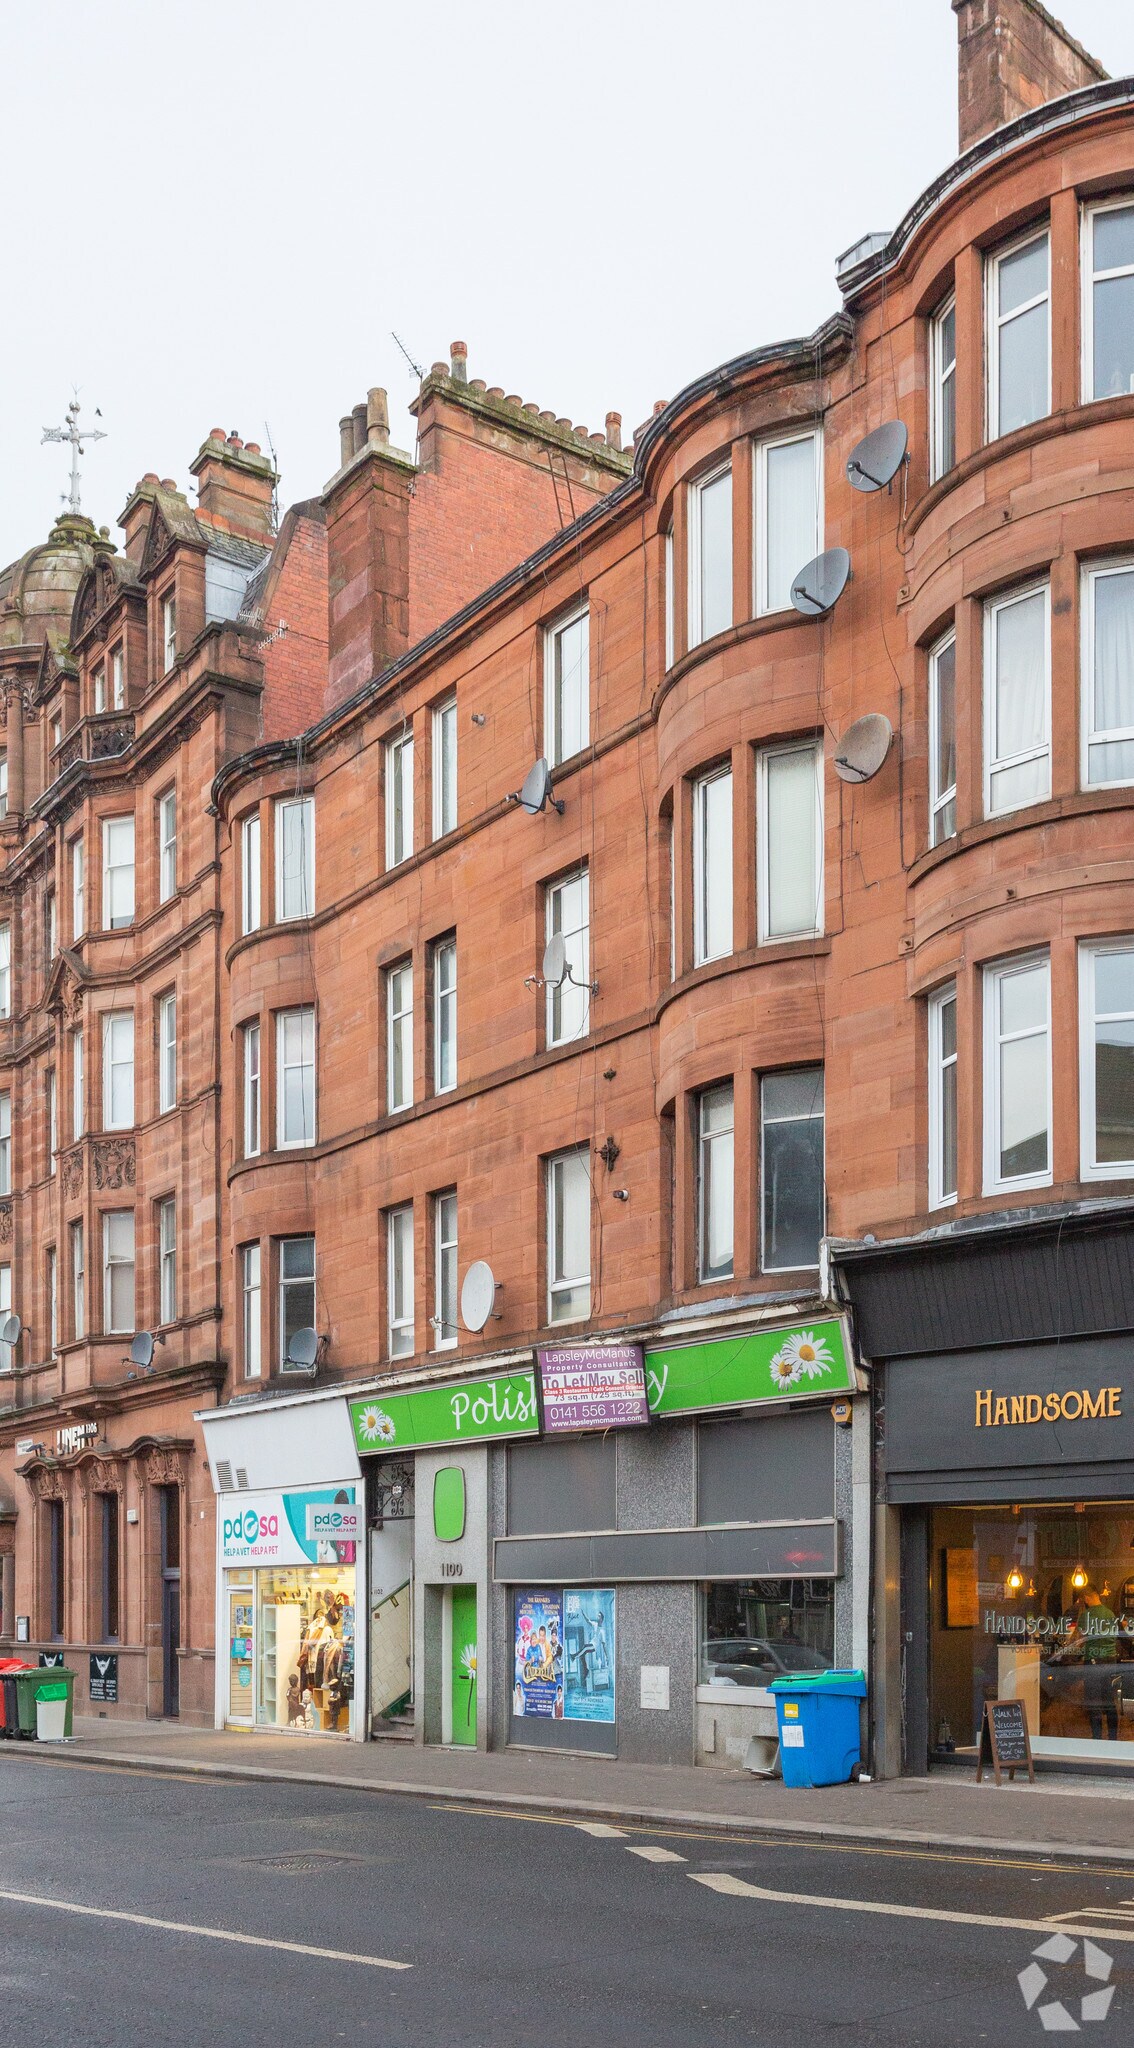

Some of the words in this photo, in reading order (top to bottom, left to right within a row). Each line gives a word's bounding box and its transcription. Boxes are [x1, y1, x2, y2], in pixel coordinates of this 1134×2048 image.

[546, 1349, 635, 1364] LapsleyMcManus
[547, 1364, 583, 1372] Property
[586, 1361, 637, 1369] Consultants
[543, 1376, 559, 1389] To
[564, 1372, 615, 1388] Let/May
[619, 1370, 643, 1385] Sell
[567, 1394, 589, 1403] sq.m
[550, 1406, 577, 1420] 0141
[582, 1404, 606, 1417] 556
[610, 1401, 641, 1415] 1222
[975, 1387, 1122, 1427] HANDSOME
[551, 1415, 642, 1428] www.lapsleymcmanus.com
[224, 1548, 236, 1557] HELP
[241, 1547, 250, 1556] VET
[251, 1546, 263, 1555] HELP
[269, 1546, 278, 1555] PET
[440, 1563, 463, 1577] 1100
[985, 1610, 1074, 1635] HANDSOME
